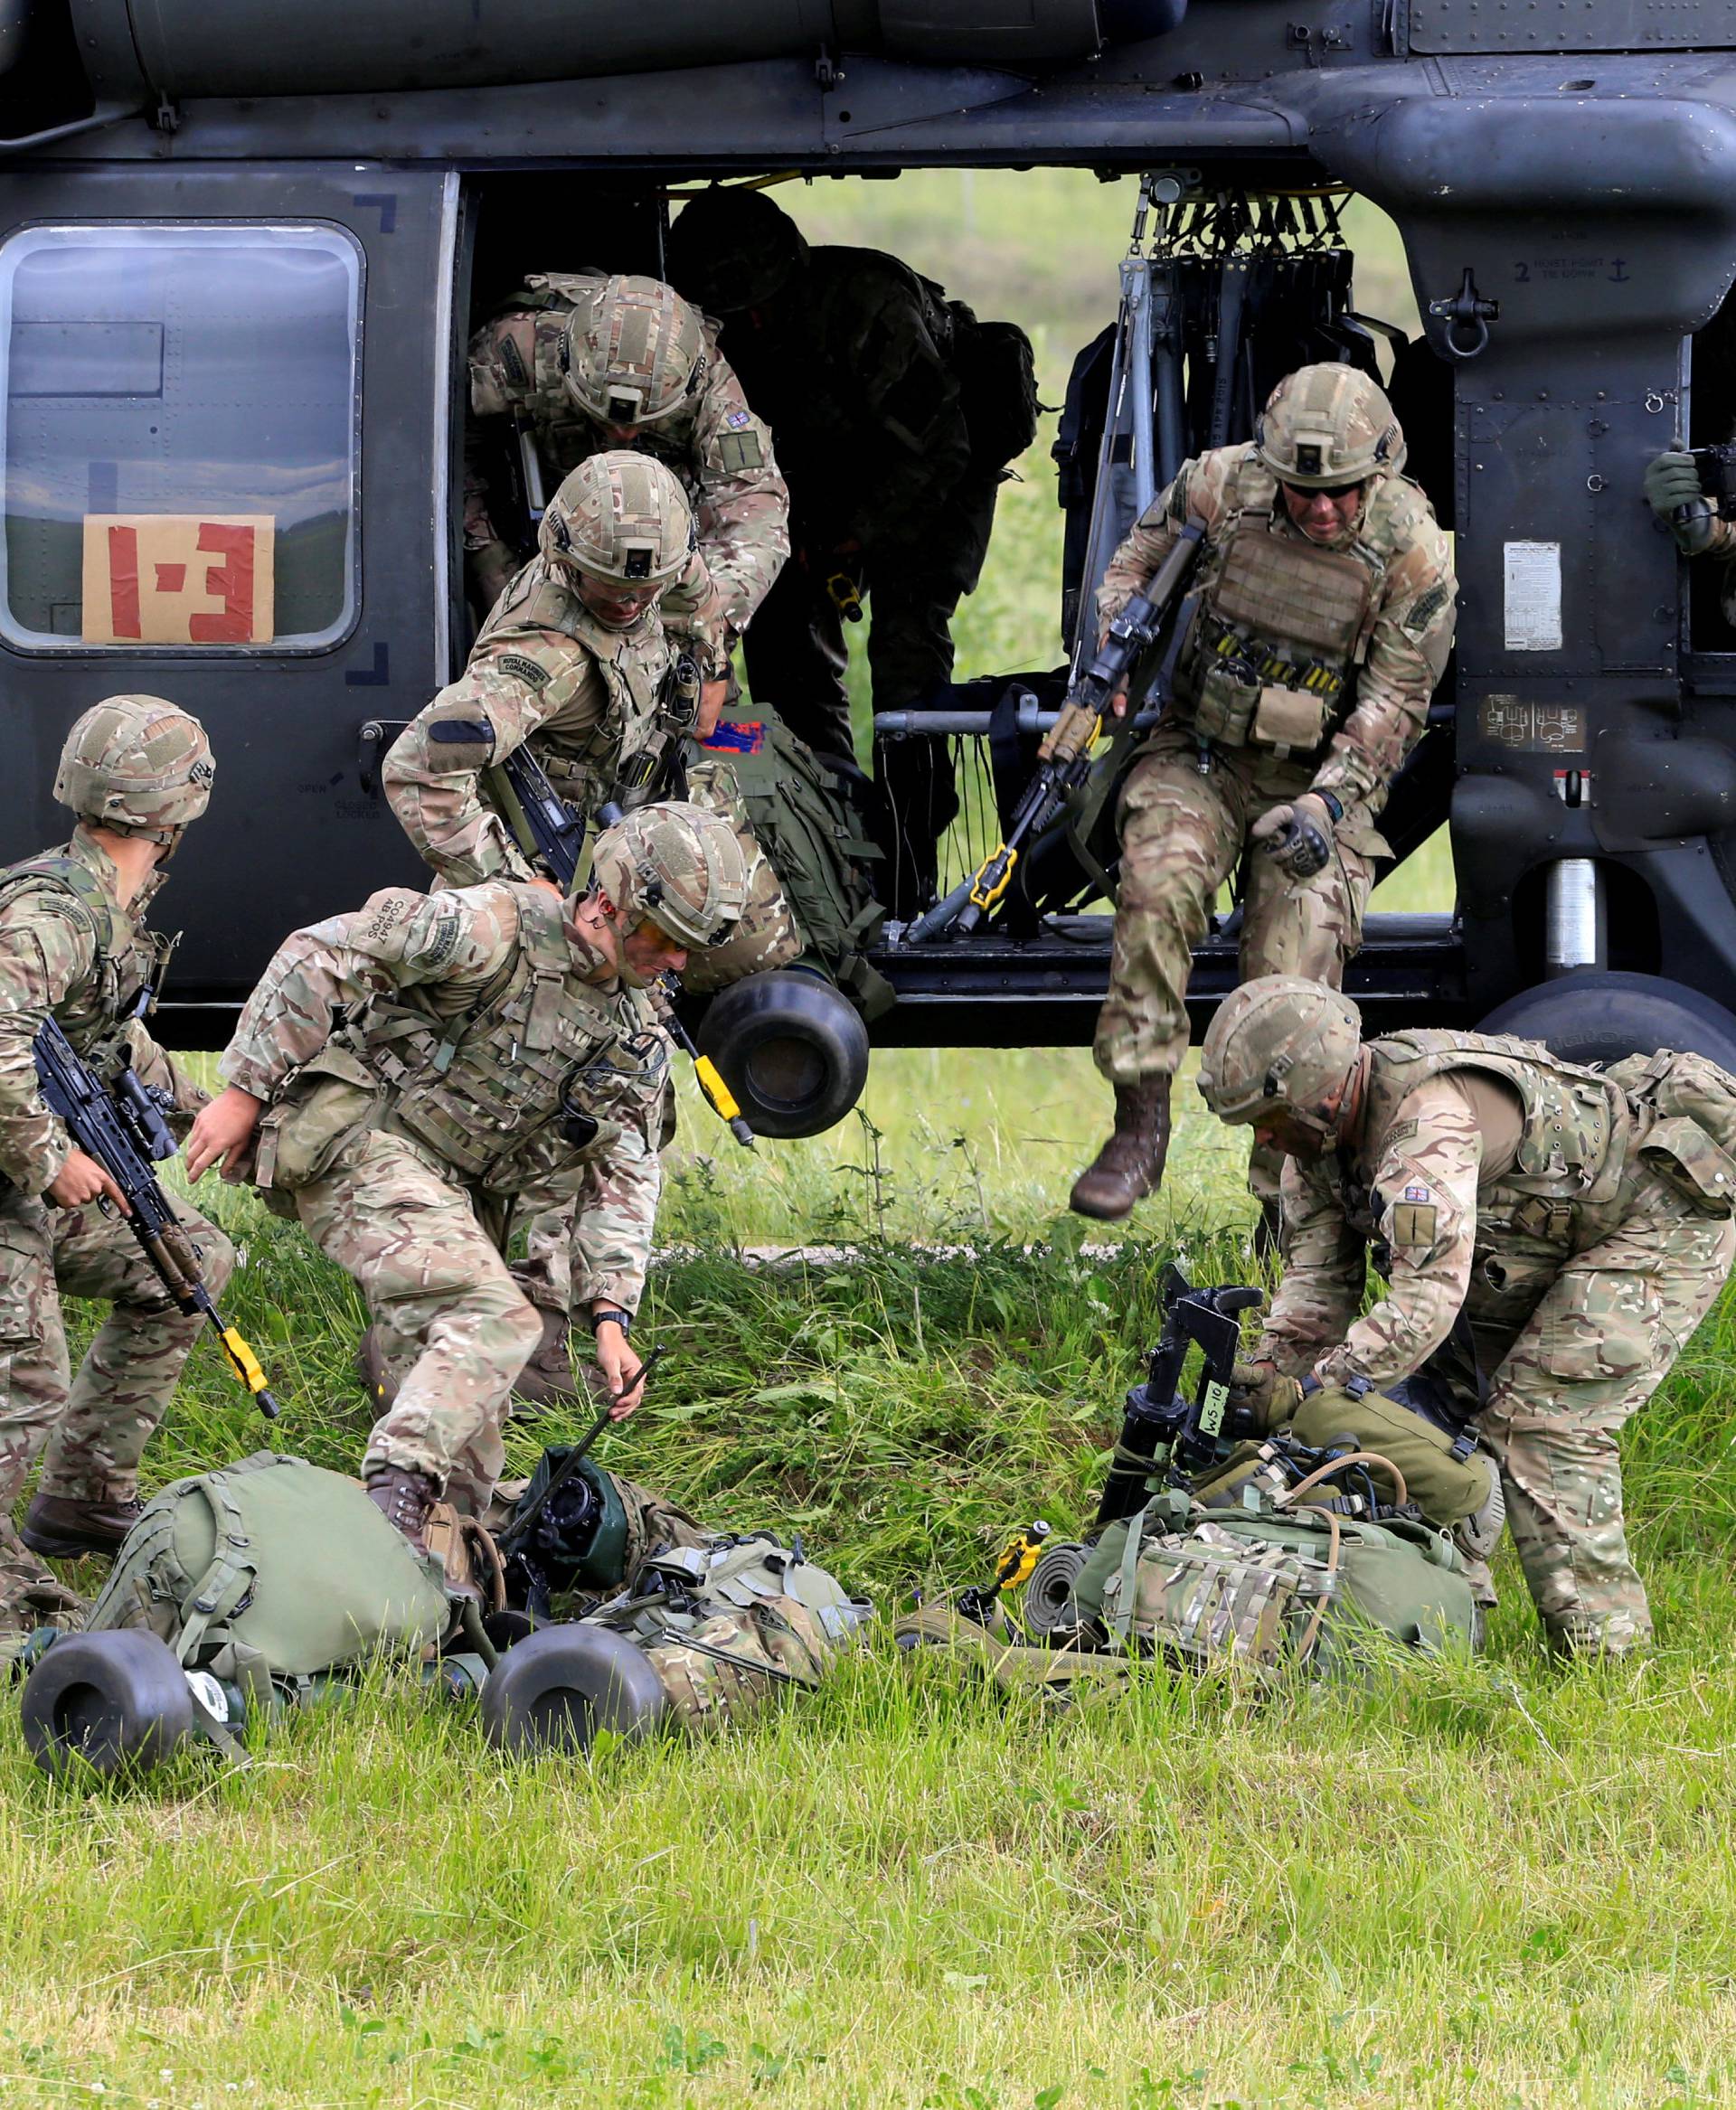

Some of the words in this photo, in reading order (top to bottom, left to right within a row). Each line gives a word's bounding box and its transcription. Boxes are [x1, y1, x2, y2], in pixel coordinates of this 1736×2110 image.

[1514, 262, 1531, 283] 2
[504, 657, 522, 665] ROYAL
[522, 661, 545, 682] MARINES
[505, 664, 538, 683] COMMANDO
[297, 784, 326, 794] OPEN
[335, 801, 376, 810] CLOSED
[336, 810, 381, 818] LOCKED
[382, 898, 394, 913] AB
[368, 915, 386, 939] POS
[446, 921, 455, 938] ROYAL
